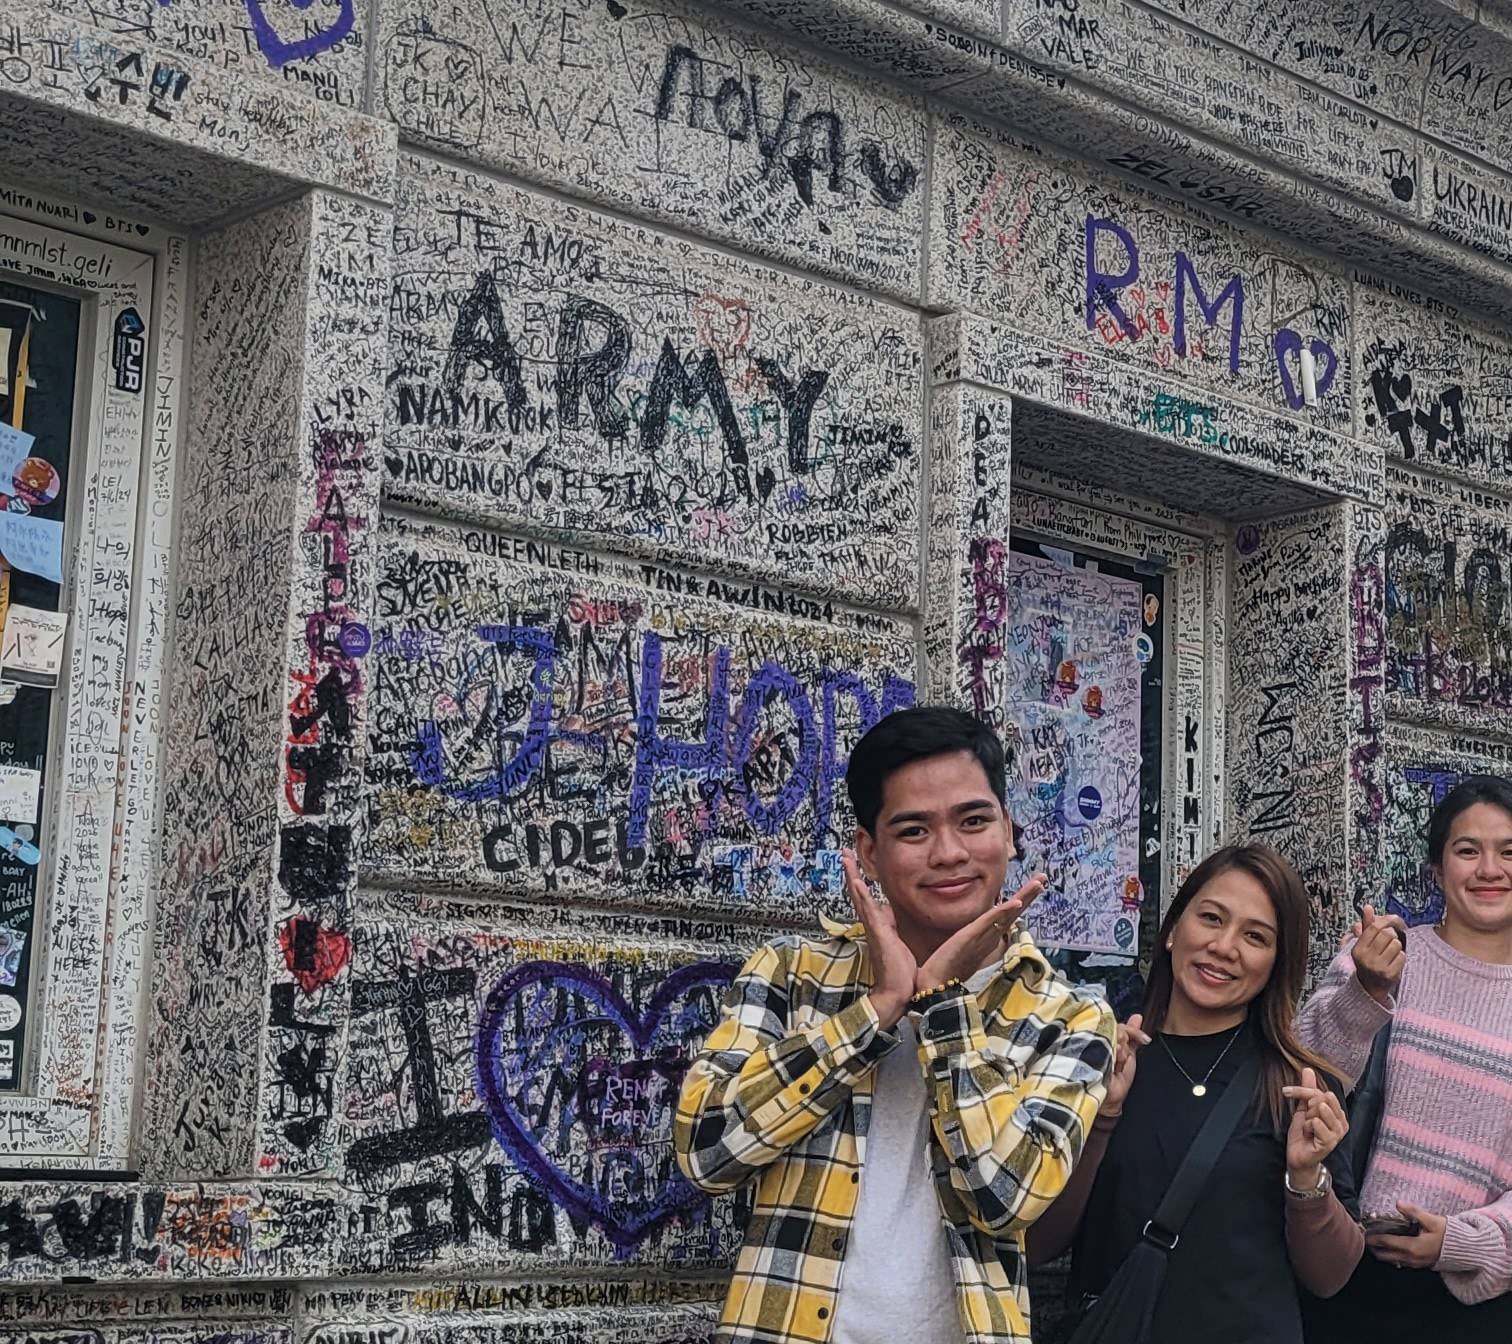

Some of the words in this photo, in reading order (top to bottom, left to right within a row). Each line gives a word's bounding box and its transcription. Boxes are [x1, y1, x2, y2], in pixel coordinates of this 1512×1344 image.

[999, 52, 1057, 89] DENISSE
[1354, 11, 1500, 94] NORWAY
[36, 200, 78, 223] NUARI
[1085, 214, 1245, 374] RM
[446, 271, 829, 474] ARMY
[155, 376, 174, 459] JIMIN
